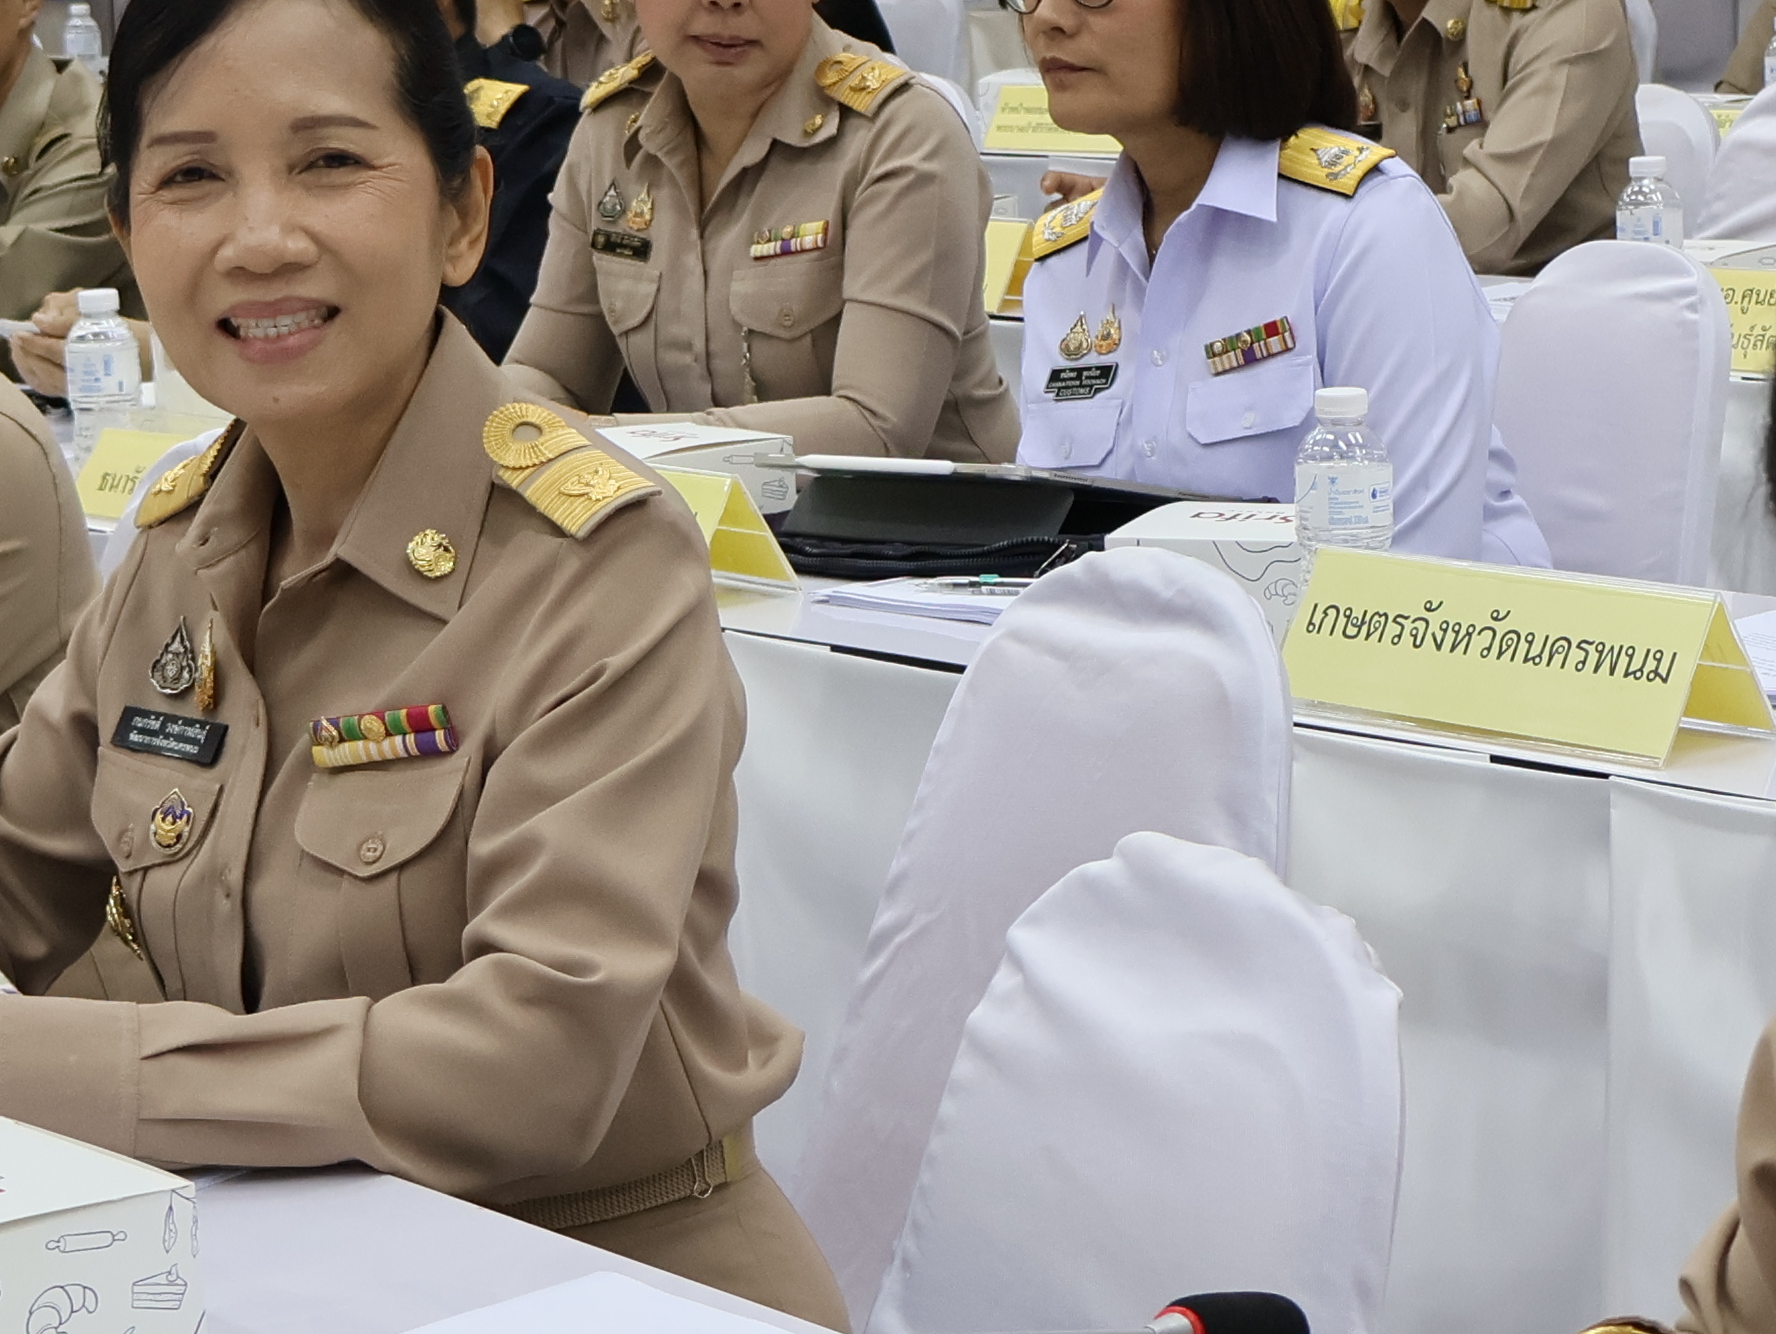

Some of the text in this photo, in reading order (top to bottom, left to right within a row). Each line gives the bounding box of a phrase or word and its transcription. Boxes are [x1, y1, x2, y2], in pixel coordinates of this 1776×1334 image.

[1059, 388, 1090, 396] CUSTOMS
[96, 465, 145, 495] ธนารั
[1305, 599, 1680, 684] เกษตรจังหวัดนครพนม
